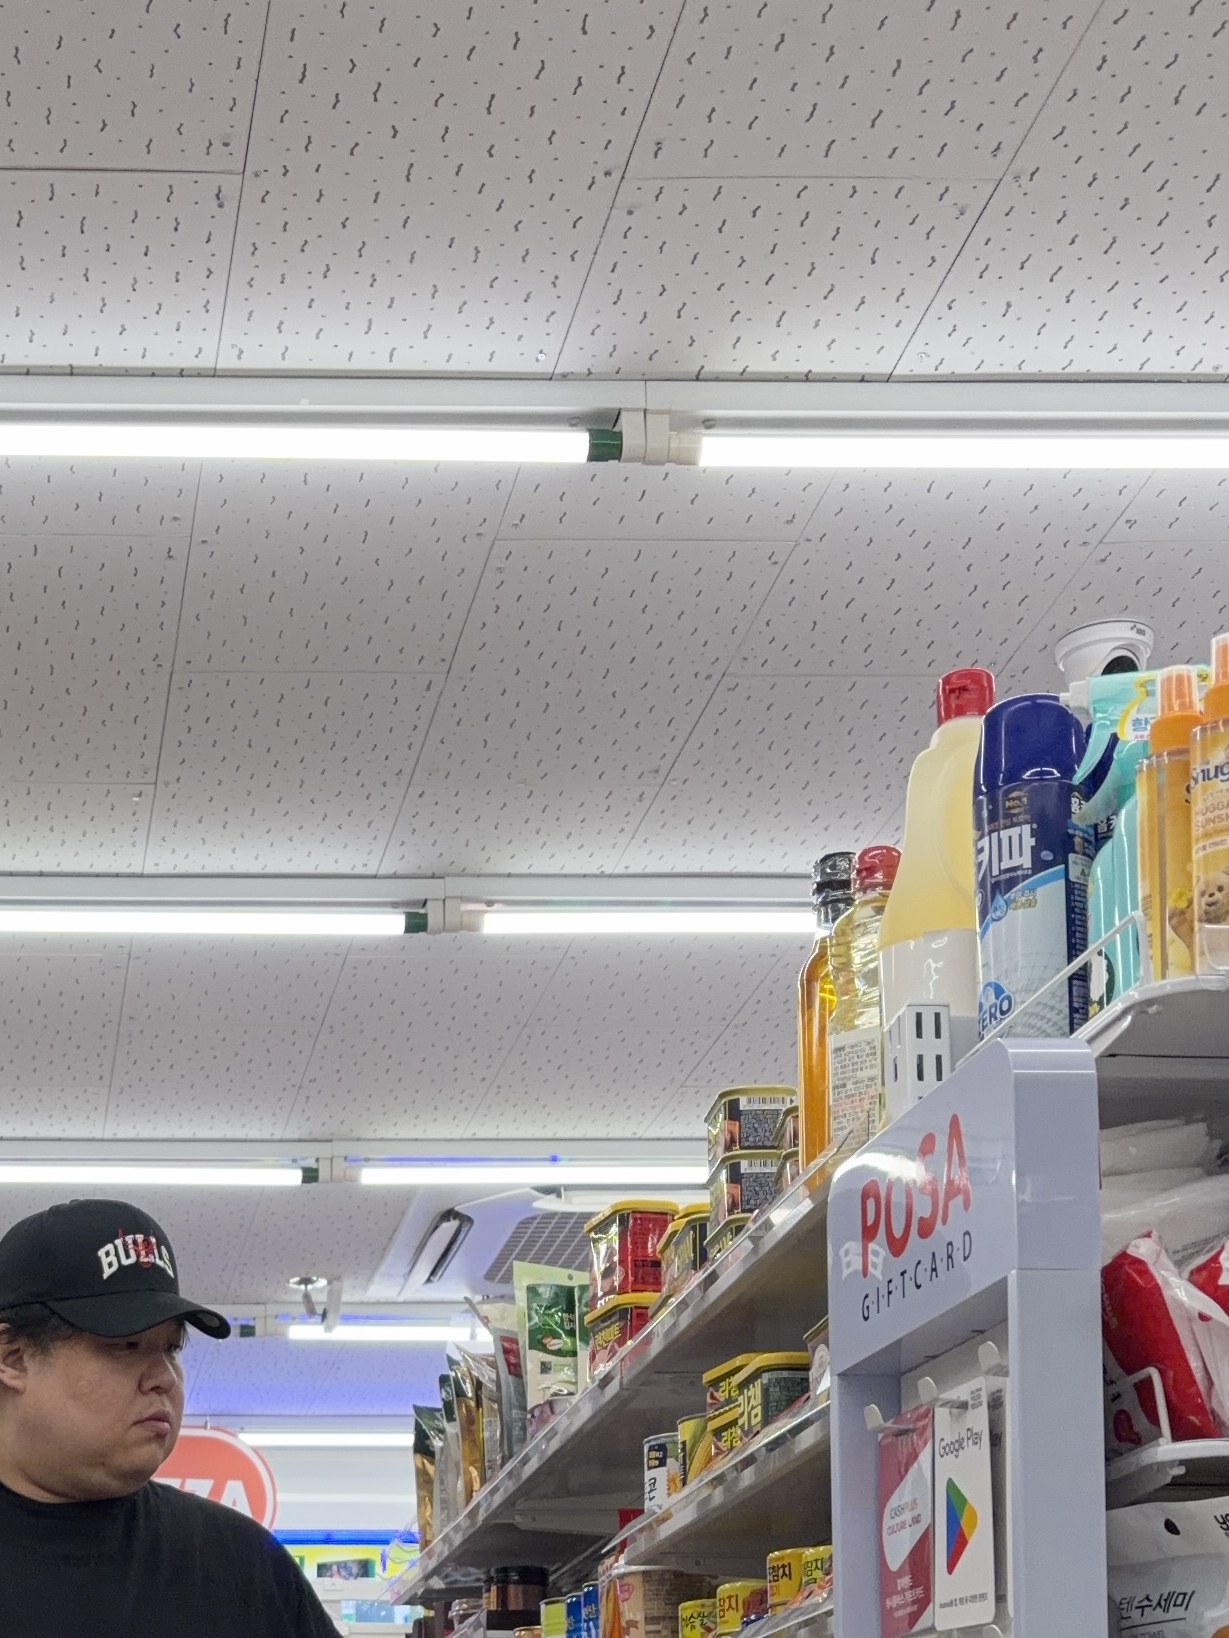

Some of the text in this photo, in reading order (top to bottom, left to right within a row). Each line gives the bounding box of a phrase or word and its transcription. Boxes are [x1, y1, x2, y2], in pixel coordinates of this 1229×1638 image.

[860, 1112, 972, 1278] POSA
[97, 1233, 175, 1280] BULLS
[938, 1427, 984, 1459] Google Play
